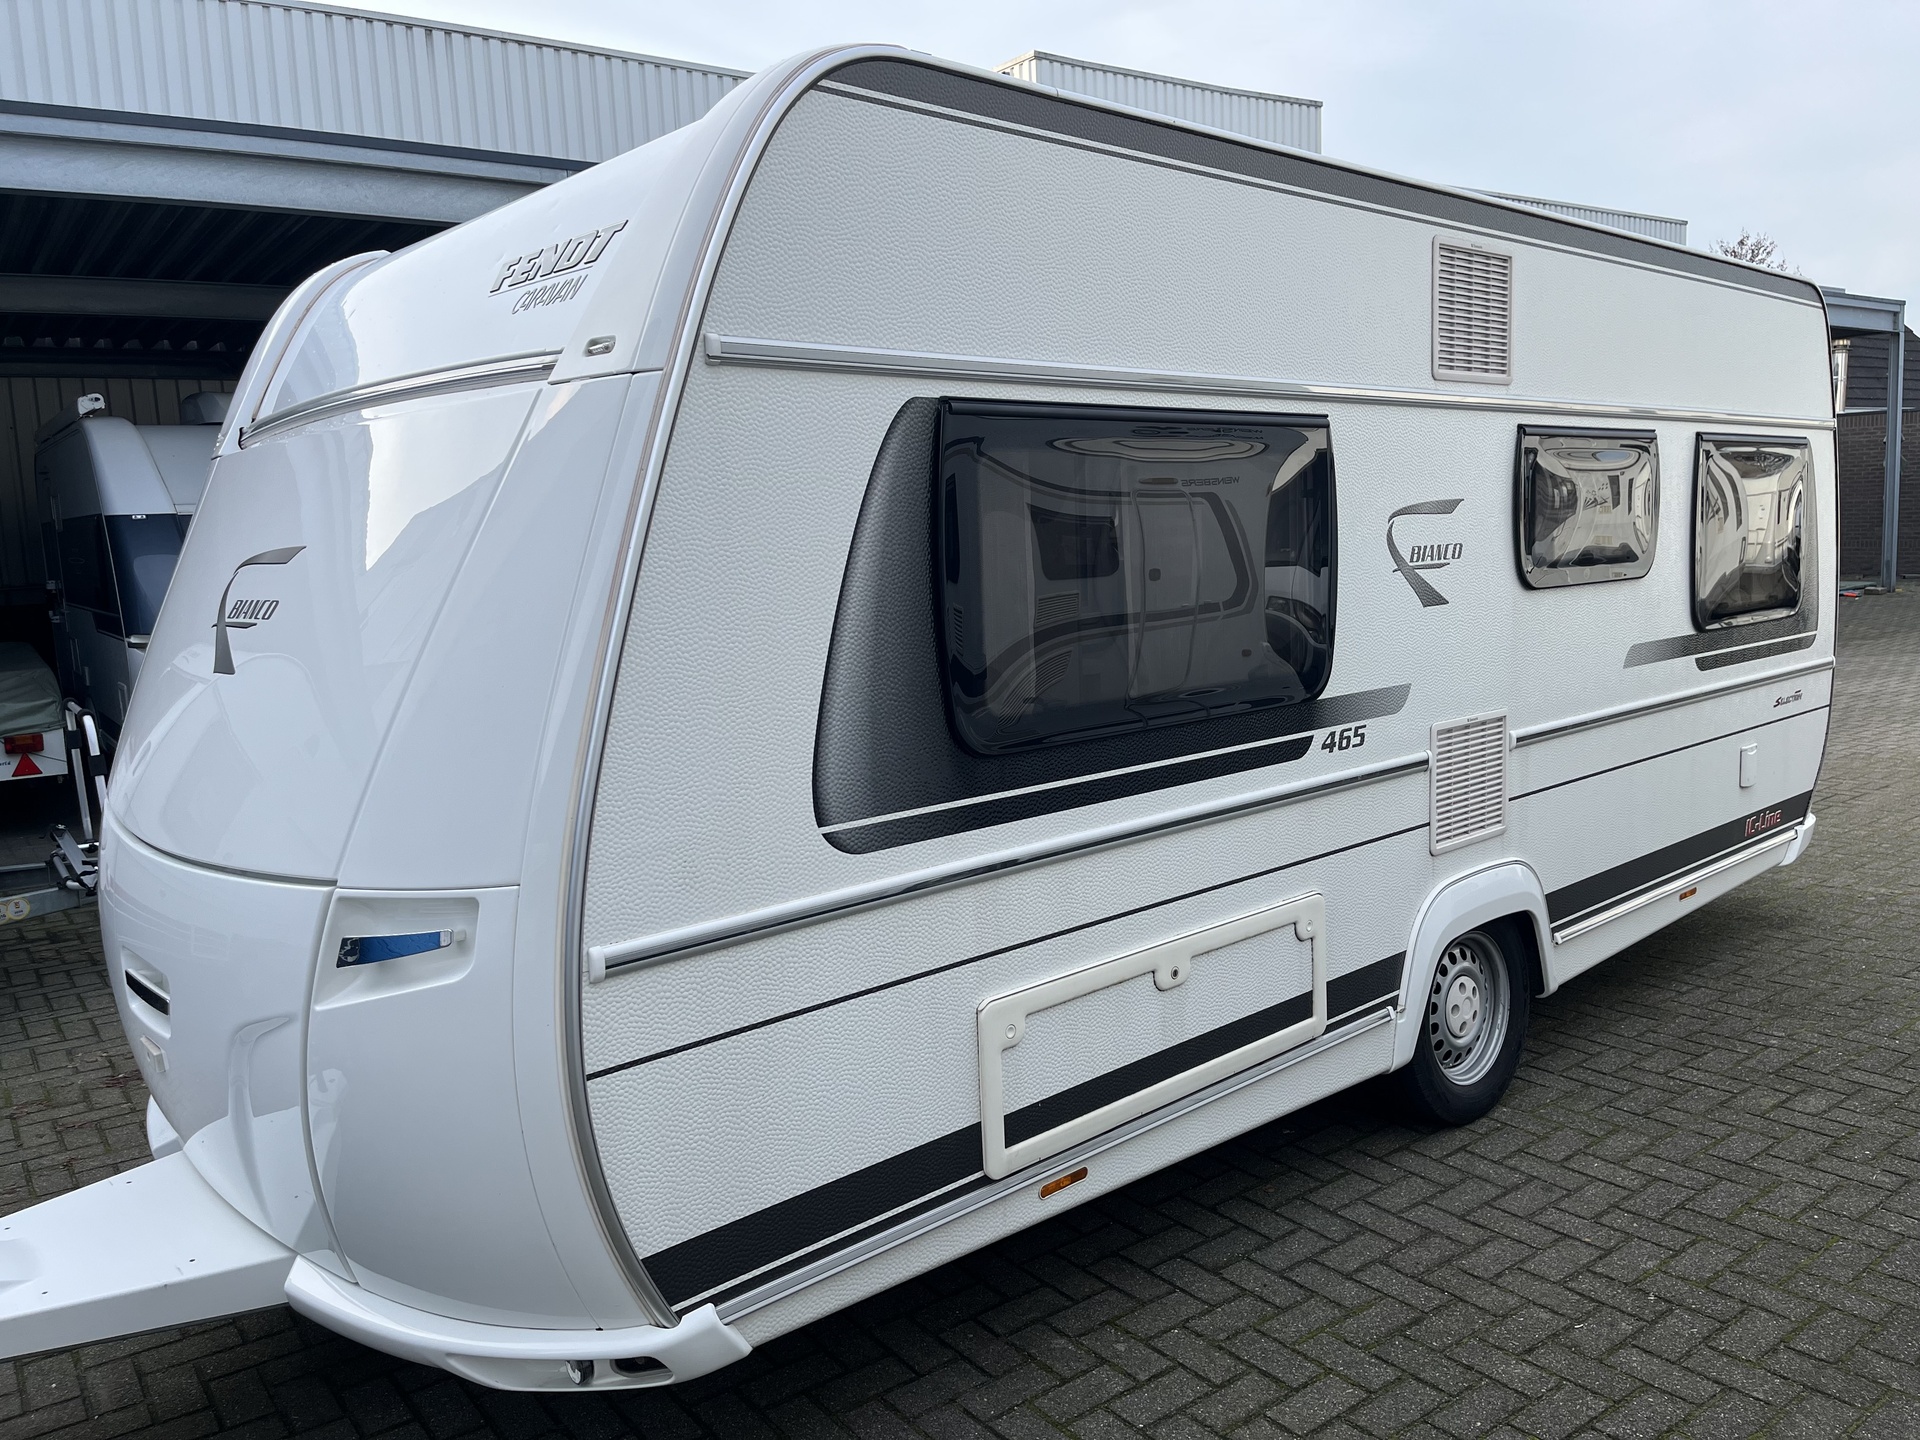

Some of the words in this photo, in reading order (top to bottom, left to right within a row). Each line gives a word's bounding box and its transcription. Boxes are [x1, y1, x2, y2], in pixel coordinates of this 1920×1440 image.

[489, 219, 629, 294] FENDT
[511, 274, 589, 315] CARAVAN
[1409, 543, 1463, 563] BIANCO
[227, 599, 280, 620] BIANCO
[1320, 724, 1367, 753] 465
